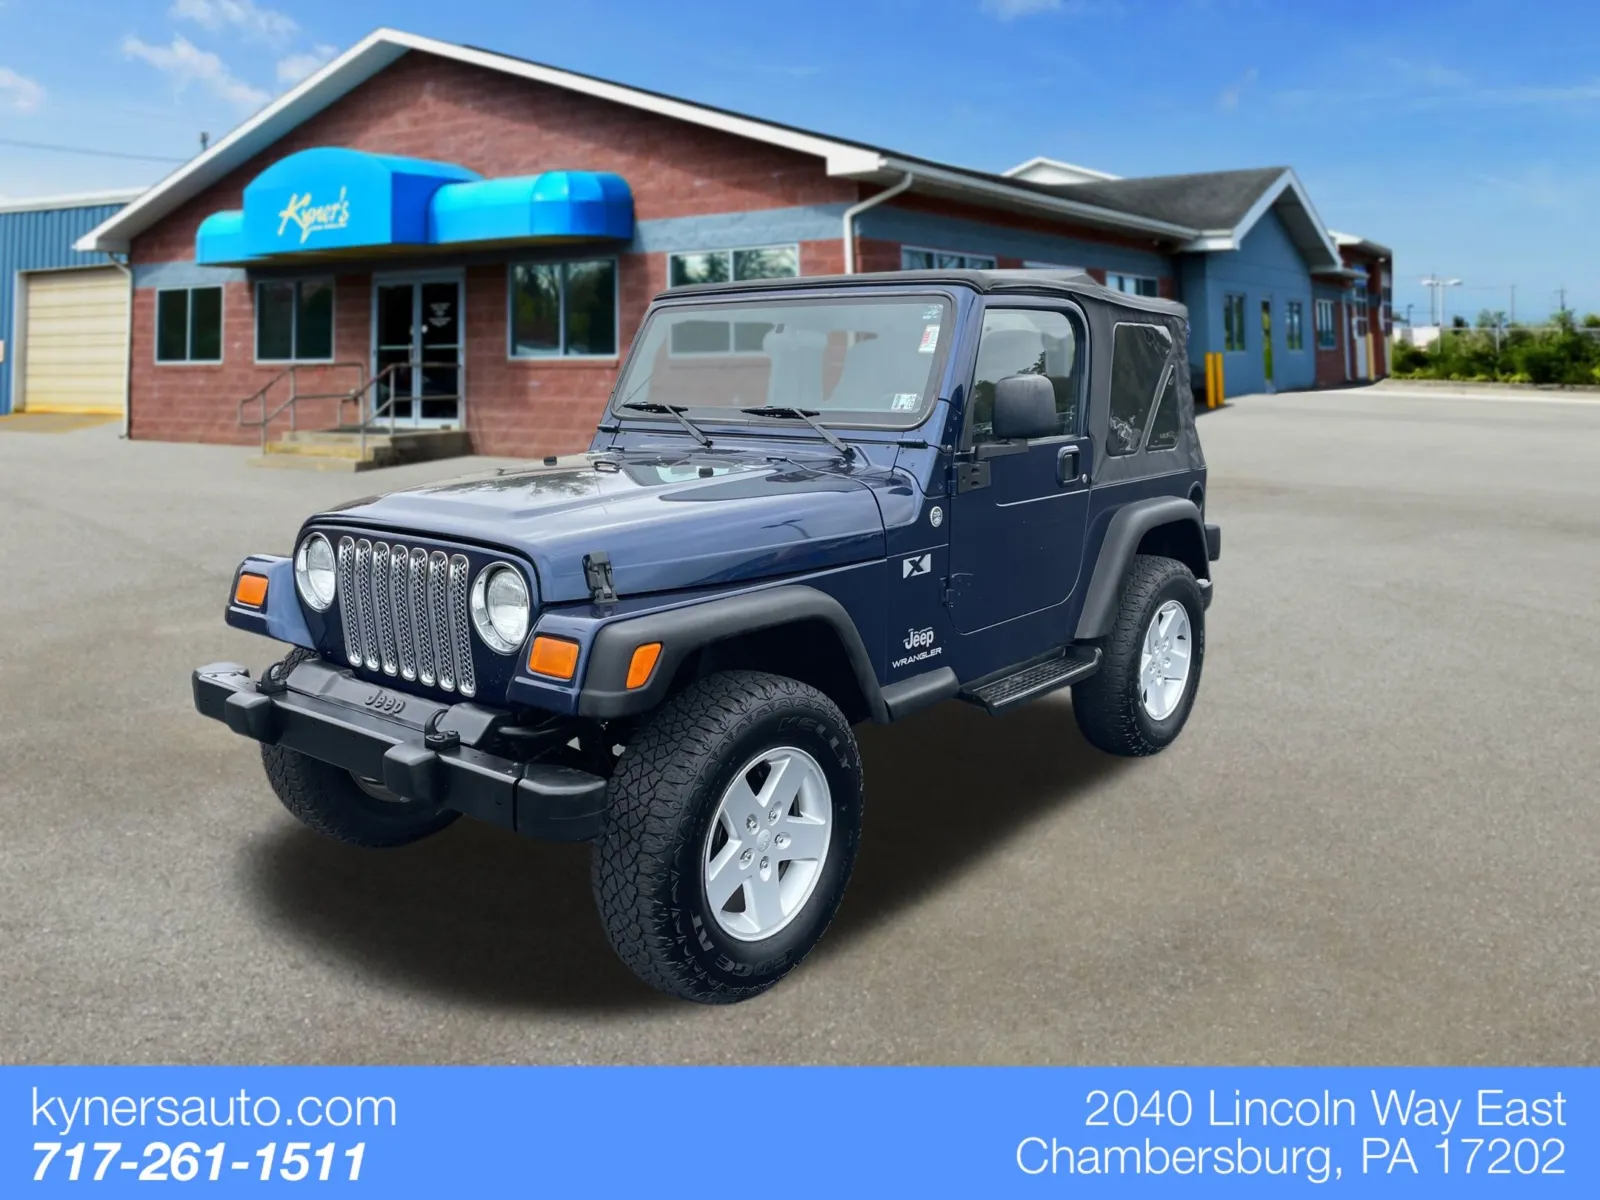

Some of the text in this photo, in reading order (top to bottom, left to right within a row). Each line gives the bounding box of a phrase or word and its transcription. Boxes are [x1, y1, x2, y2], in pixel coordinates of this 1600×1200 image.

[903, 626, 934, 650] Jeep
[892, 647, 942, 669] WRANGLER
[365, 690, 406, 716] Jeep
